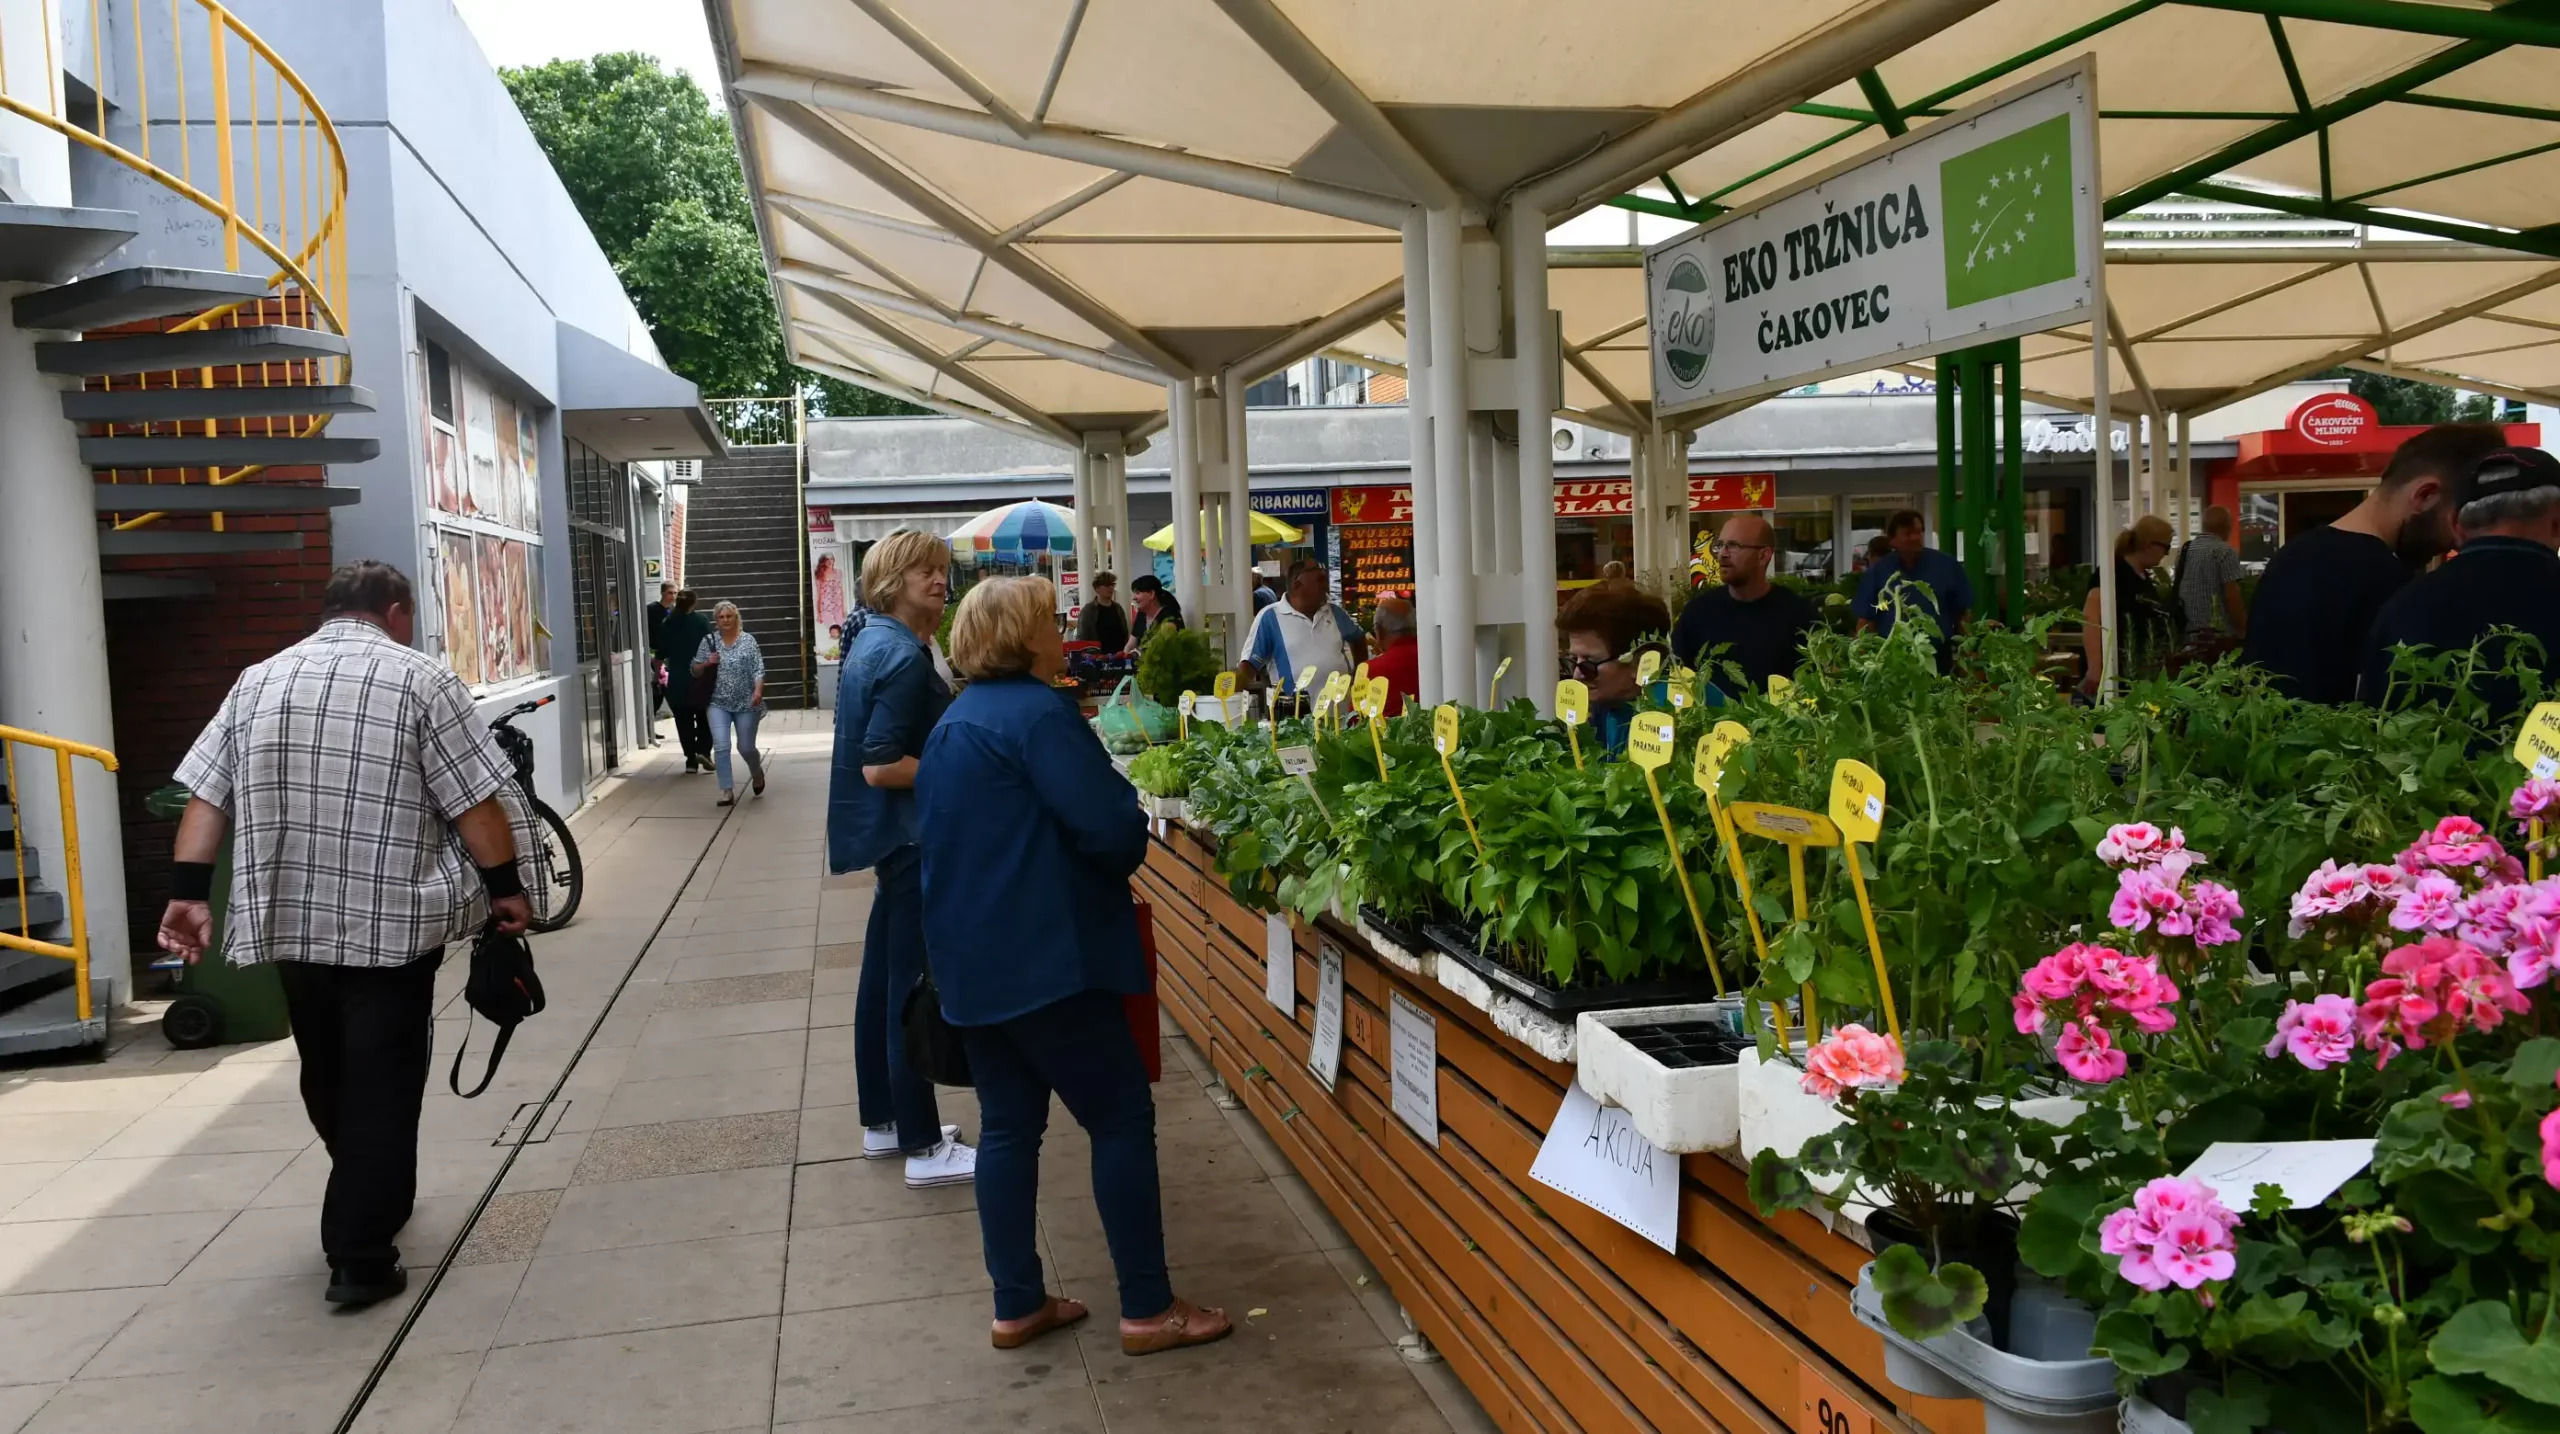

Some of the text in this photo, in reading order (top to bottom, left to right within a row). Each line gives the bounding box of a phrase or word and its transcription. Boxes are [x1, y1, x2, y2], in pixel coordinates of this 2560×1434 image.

[1722, 183, 1929, 303] EKO TRŽNICA
[1667, 295, 1705, 348] eko
[1757, 284, 1890, 354] ČAKOVEC
[2307, 414, 2364, 427] ČAKOVEČKI
[2315, 426, 2358, 435] MLINOVI
[1250, 493, 1324, 510] RIBARNICA
[1354, 553, 1402, 568] pilića
[1355, 567, 1410, 580] kokoši
[1583, 1104, 1654, 1187] AKCIJA
[1818, 1397, 1850, 1434] 90
